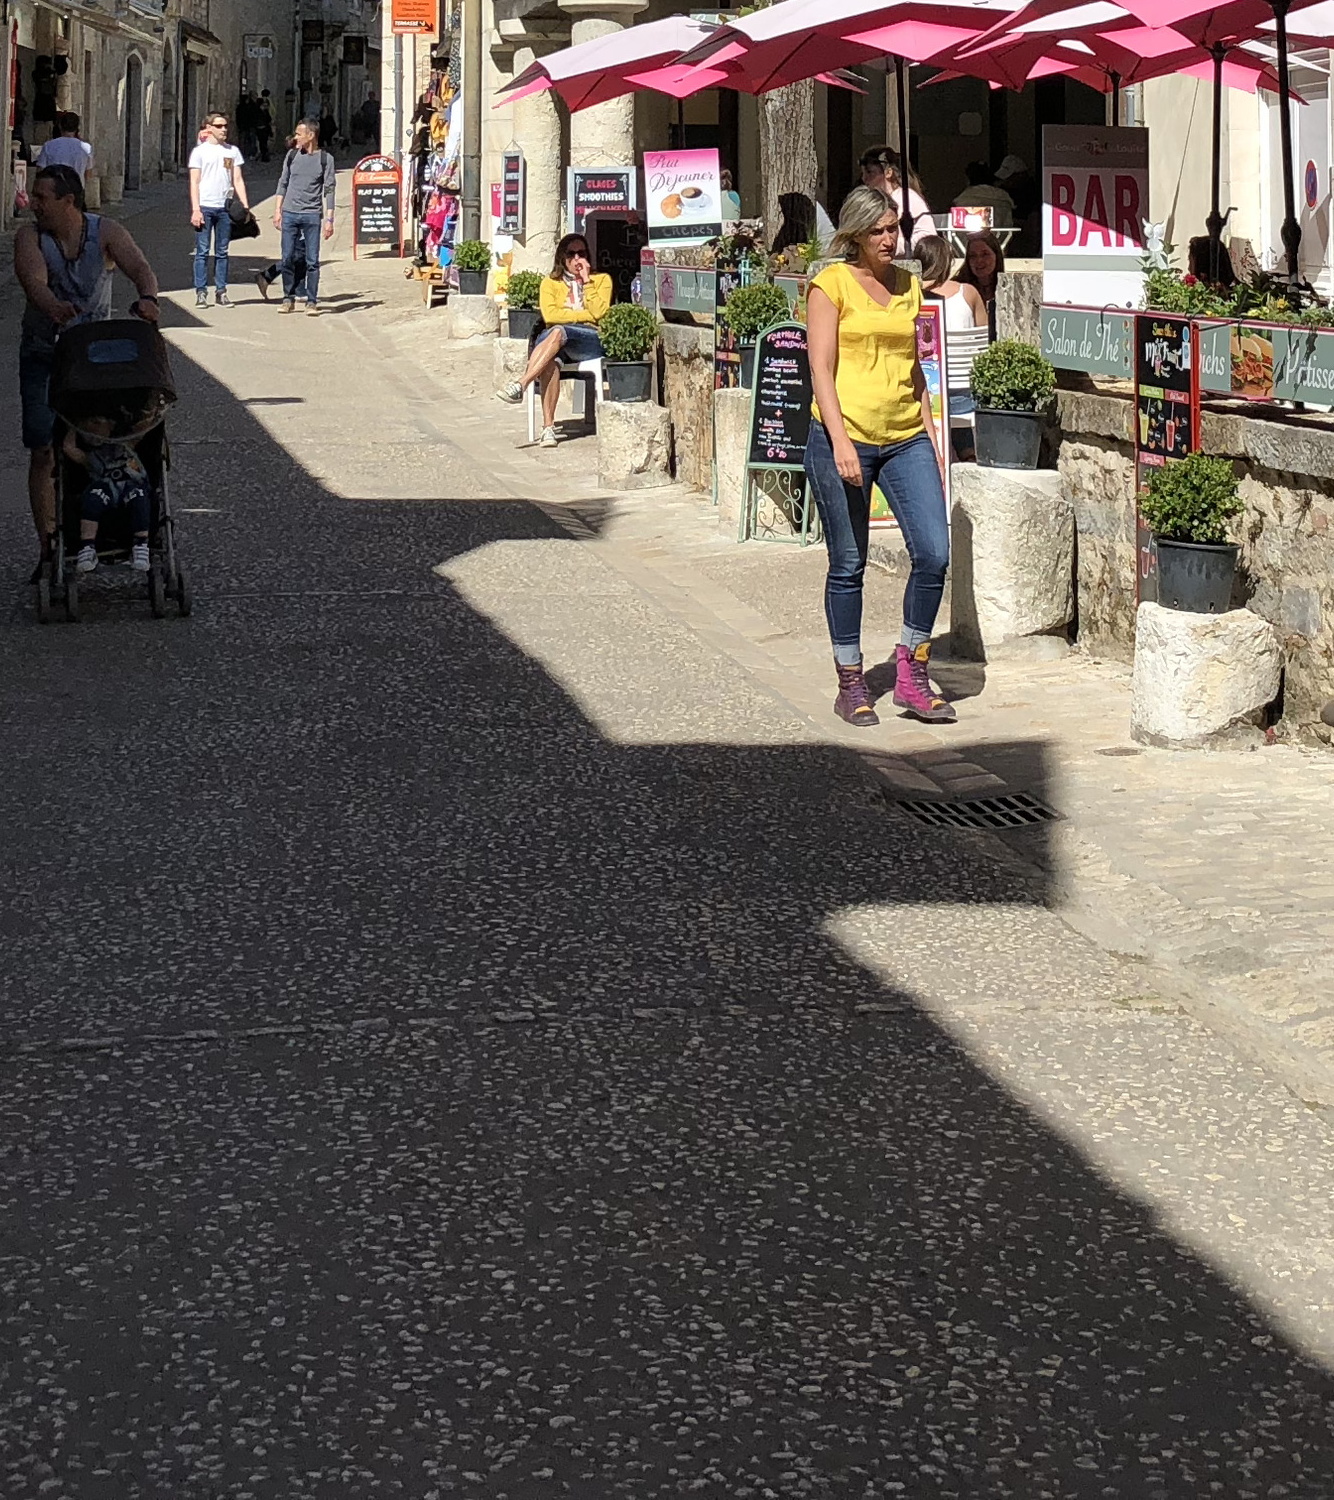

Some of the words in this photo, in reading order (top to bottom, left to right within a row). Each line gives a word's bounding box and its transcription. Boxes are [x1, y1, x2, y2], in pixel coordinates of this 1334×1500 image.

[586, 179, 617, 189] GLACES
[578, 192, 625, 202] SMOOTHIES
[1050, 173, 1143, 248] BAR
[767, 330, 802, 343] FORMULE
[1045, 317, 1077, 357] Salon
[1079, 318, 1093, 359] de
[1094, 320, 1120, 363] Thé
